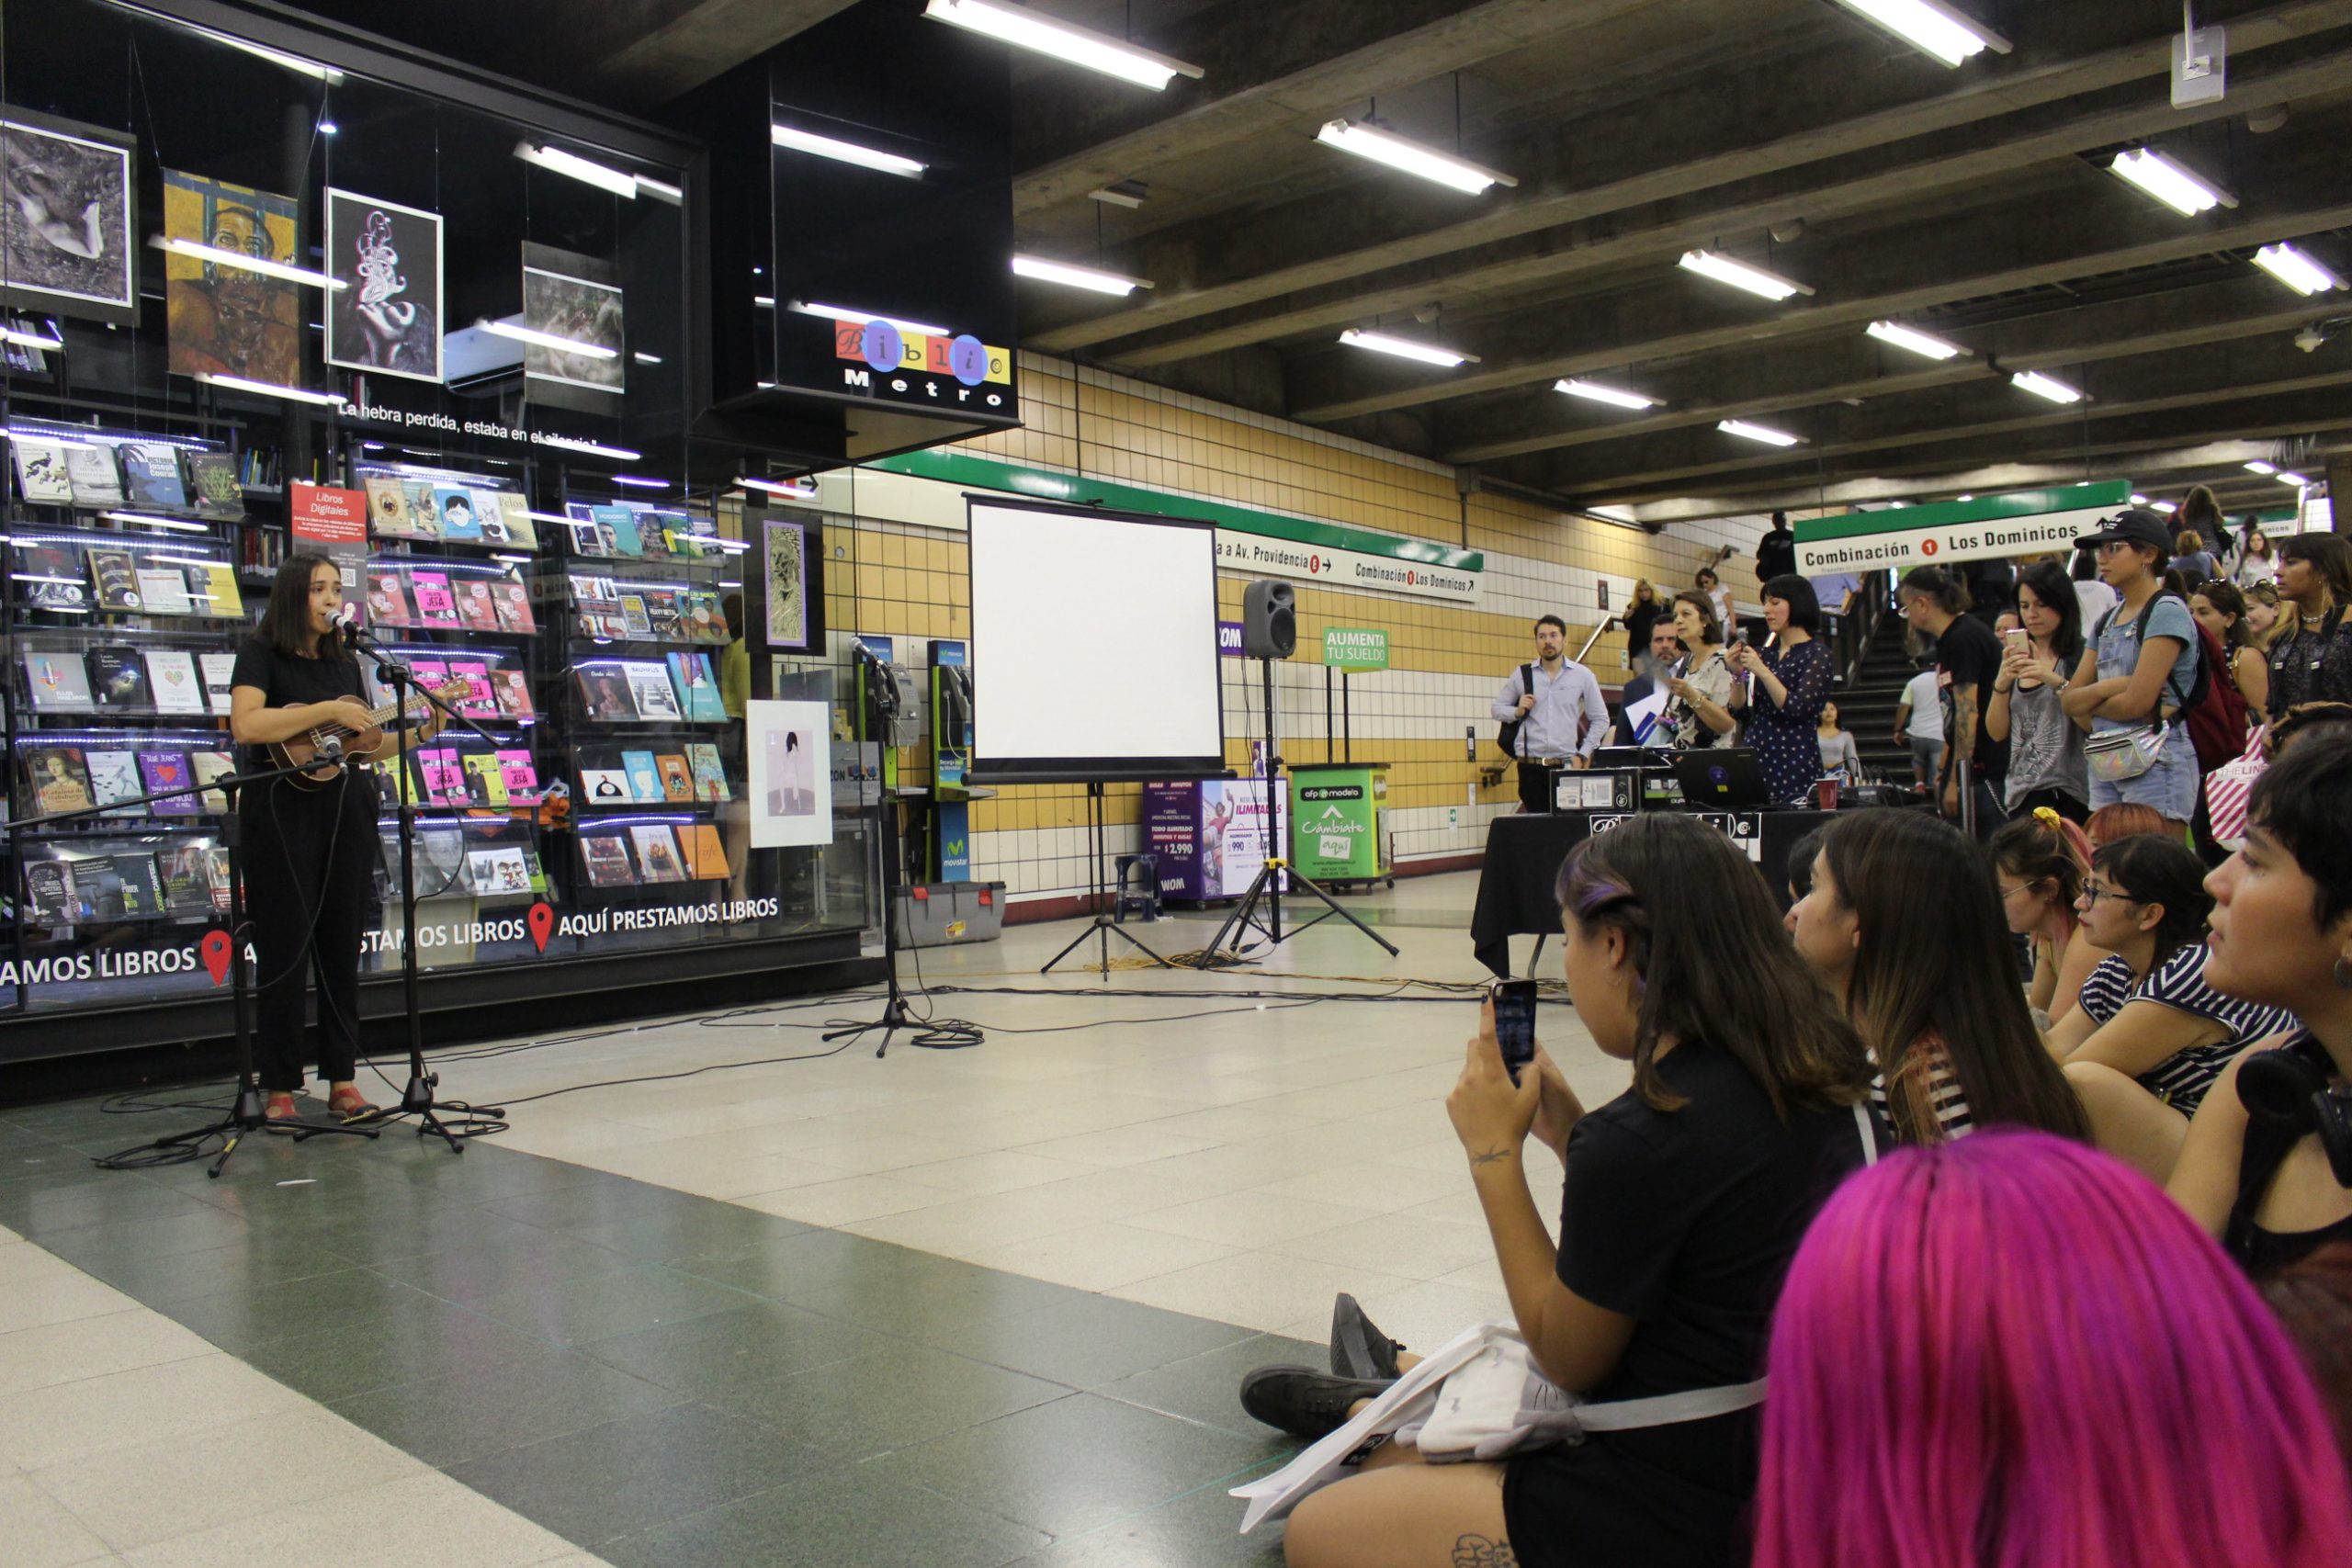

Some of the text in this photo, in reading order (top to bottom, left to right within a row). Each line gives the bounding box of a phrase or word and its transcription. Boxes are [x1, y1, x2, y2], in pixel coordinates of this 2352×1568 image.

[843, 368, 1002, 407] Metro
[361, 402, 401, 423] hebra
[405, 412, 460, 434] perdida,
[464, 421, 508, 439] estaba
[511, 428, 527, 442] en
[316, 491, 344, 504] Libros
[499, 496, 525, 509] Pelos
[310, 502, 349, 516] Digitales
[1804, 542, 1910, 568] Combinación
[1949, 535, 1978, 550] Los
[1984, 525, 2079, 547] Dominicos
[1226, 545, 1233, 556] a
[1235, 543, 1250, 559] Av.
[1253, 546, 1308, 569] Providencia
[1355, 562, 1407, 582] Combinación
[1415, 570, 1429, 586] Los
[1430, 573, 1466, 592] Dominicos
[1219, 627, 1242, 648] OM
[1327, 632, 1385, 648] AUMENTA
[1327, 647, 1385, 661] TU SUELDO
[1305, 788, 1359, 799] afp modelo
[1236, 804, 1282, 815] ILIMITADS
[1301, 819, 1366, 834] Cámbiate
[1322, 839, 1349, 856] aquí
[1160, 877, 1185, 892] WOM
[558, 897, 778, 937] AQUÍ PRESTAMOS LIBROS
[453, 919, 526, 945] LIBROS
[0, 947, 197, 987] AMOS LIBROS
